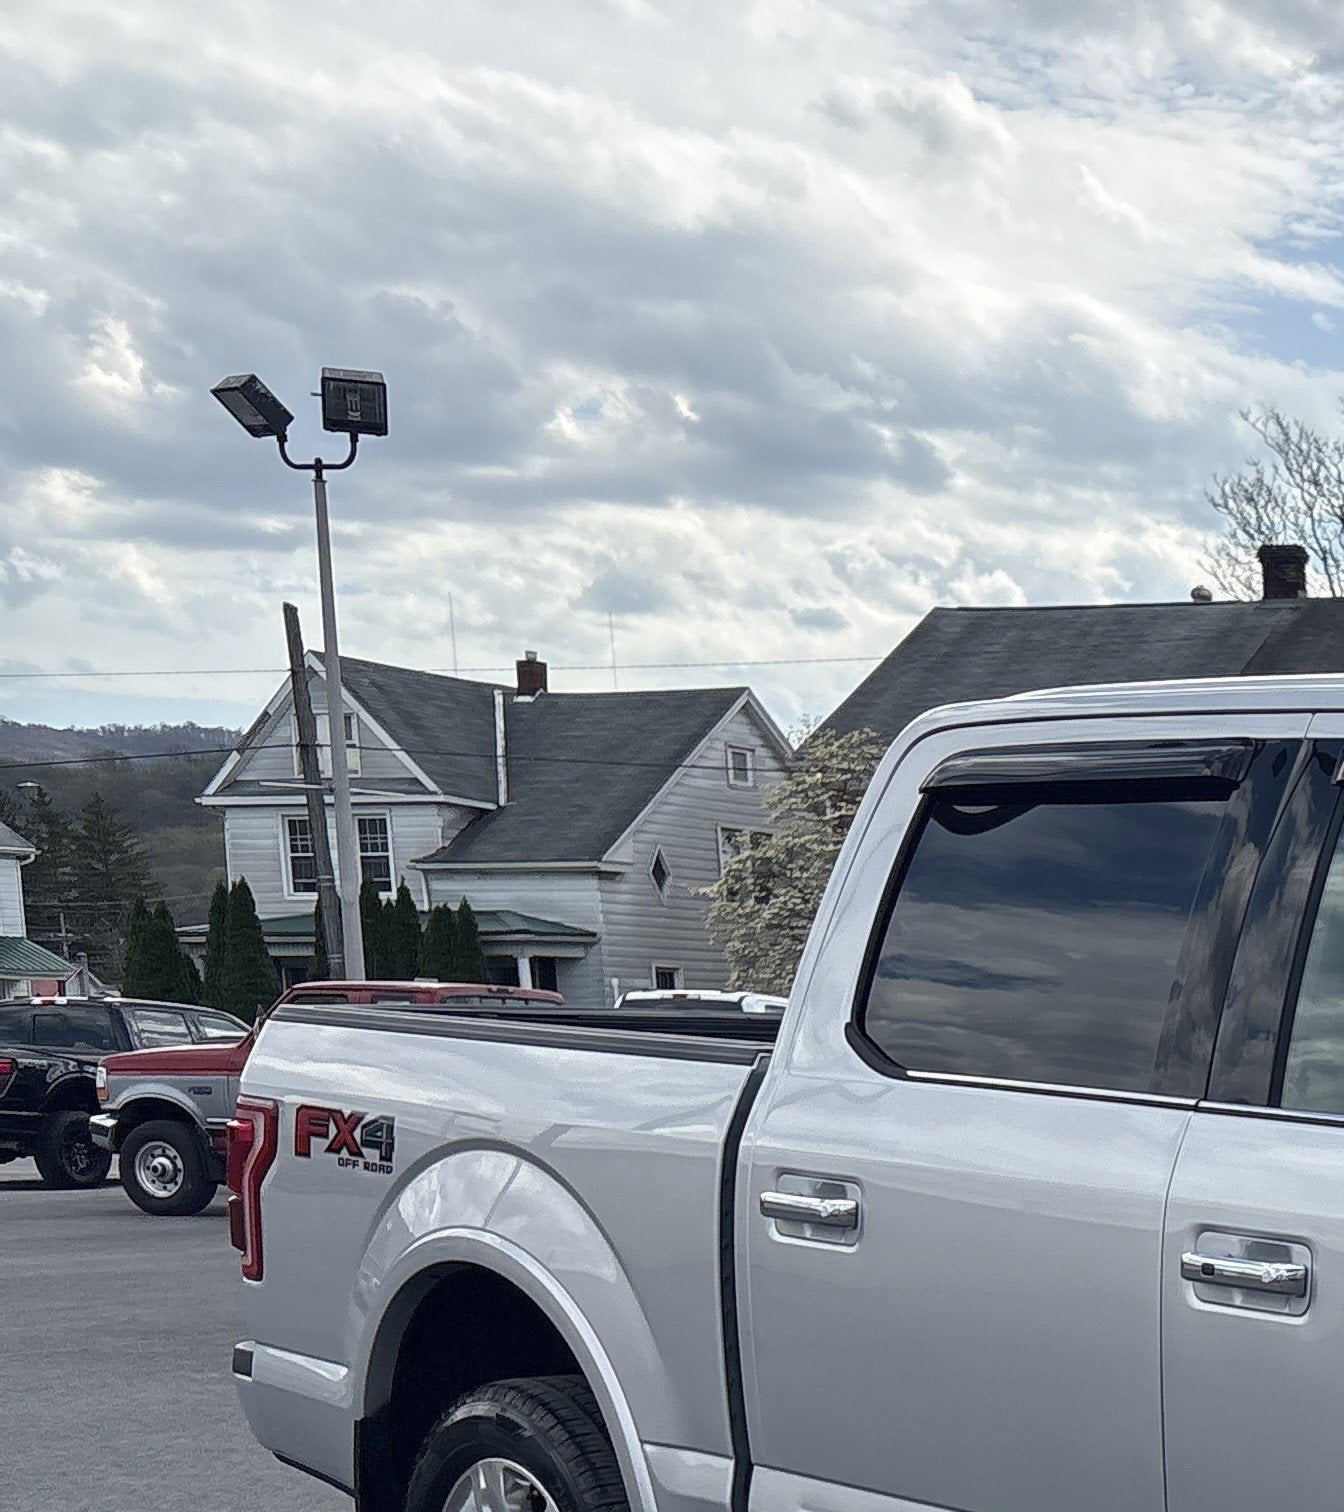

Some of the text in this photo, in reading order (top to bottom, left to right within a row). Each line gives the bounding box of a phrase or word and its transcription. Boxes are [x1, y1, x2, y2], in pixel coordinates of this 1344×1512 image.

[295, 1104, 396, 1162] FX4
[337, 1156, 393, 1175] OFF ROAD
